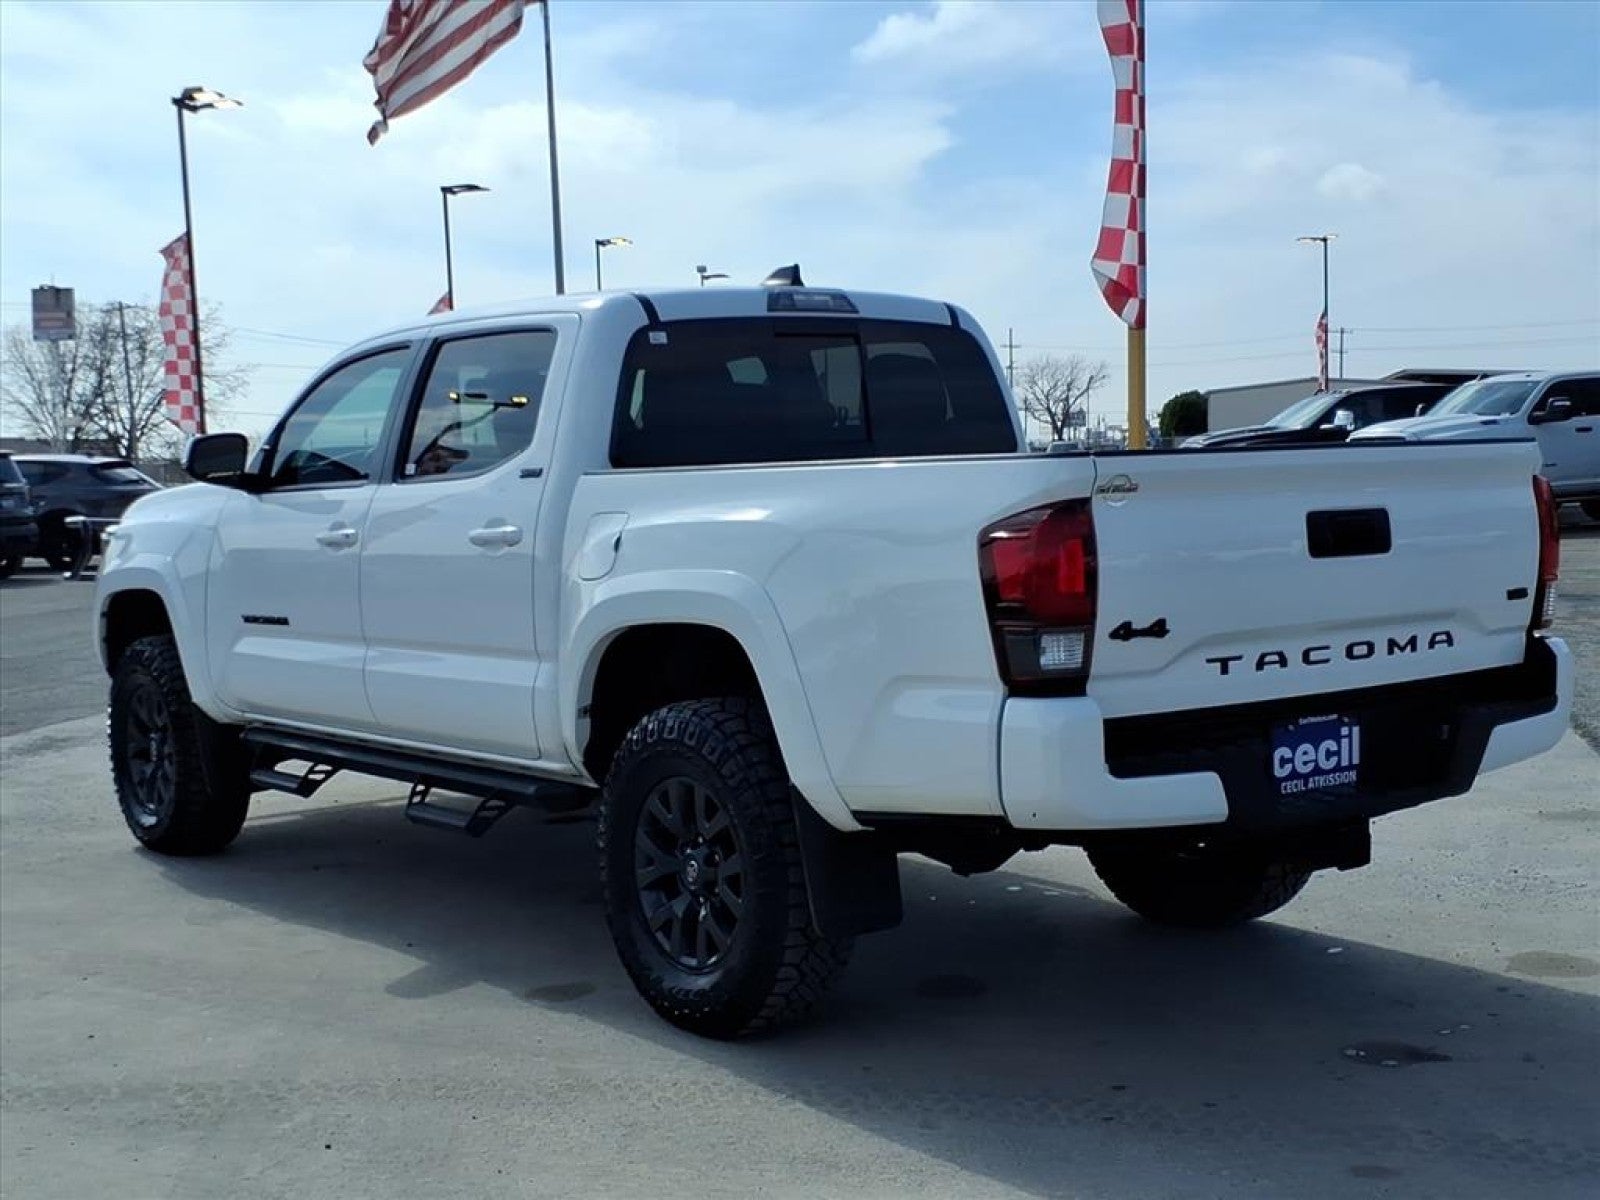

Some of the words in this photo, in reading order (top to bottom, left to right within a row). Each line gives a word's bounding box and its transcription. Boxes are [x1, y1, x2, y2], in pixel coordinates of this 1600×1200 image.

[1205, 630, 1455, 676] TACOMA
[1273, 725, 1360, 778] cecil
[1280, 778, 1306, 795] CECIL
